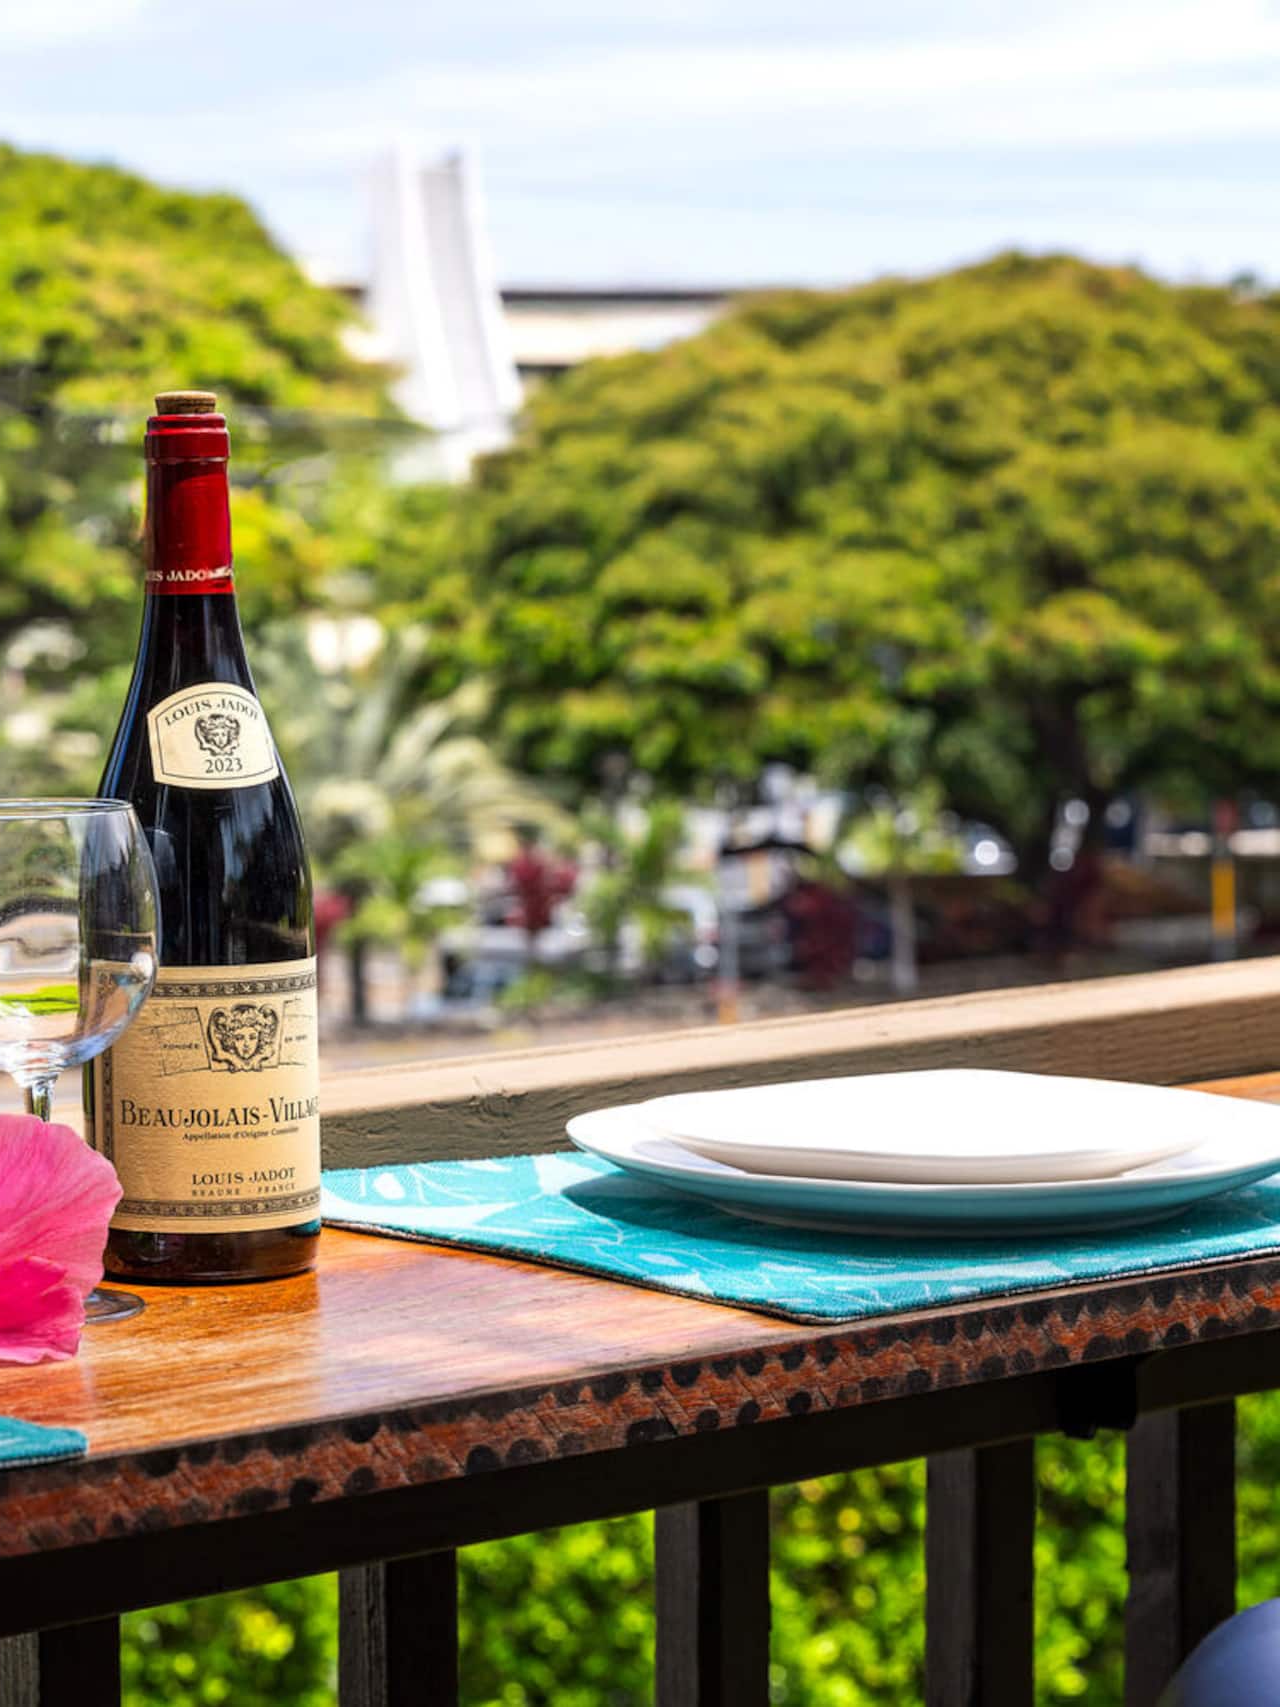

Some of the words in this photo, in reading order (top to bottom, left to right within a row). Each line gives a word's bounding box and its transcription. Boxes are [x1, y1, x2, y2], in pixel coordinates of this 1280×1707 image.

[165, 699, 212, 726] LOUIS
[205, 757, 243, 774] 2023
[192, 1171, 244, 1185] LOUIS
[249, 1166, 296, 1183] JADOT
[257, 1182, 296, 1193] FRANCE
